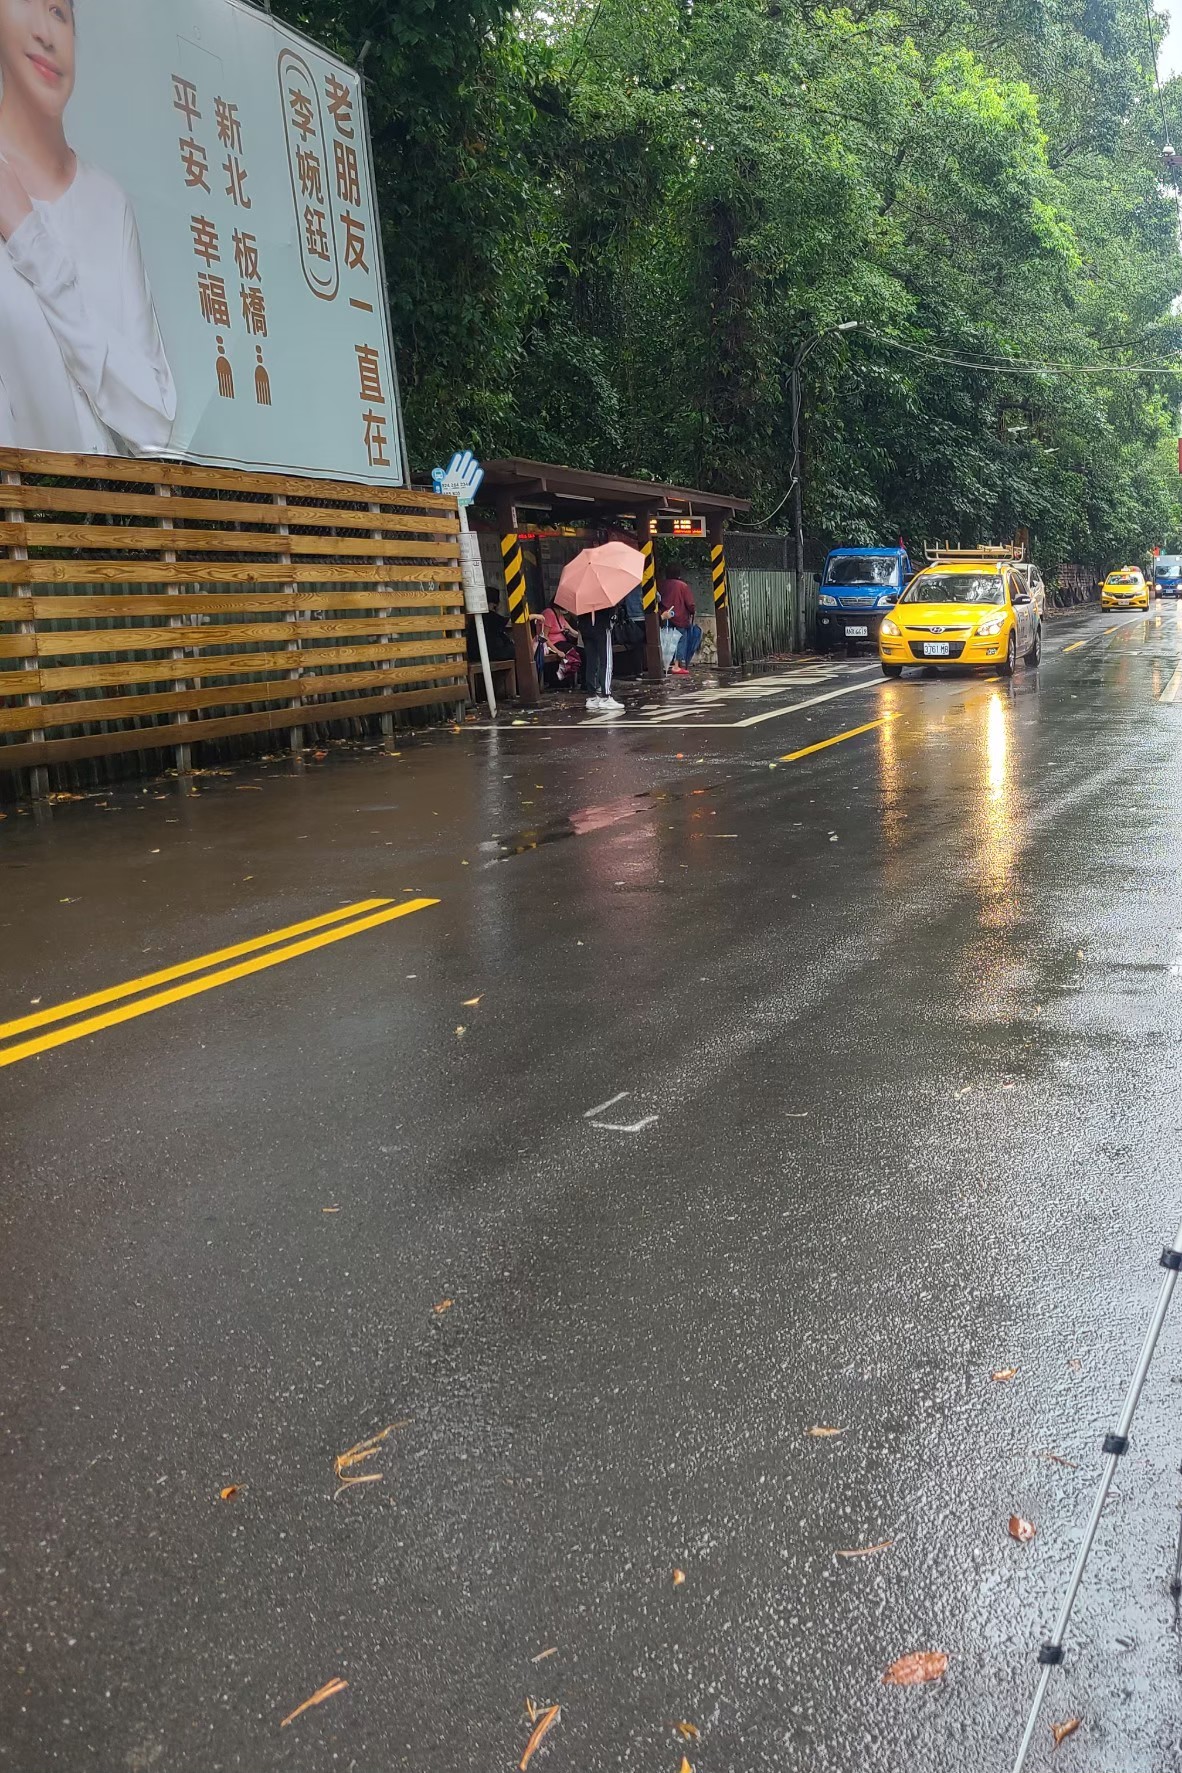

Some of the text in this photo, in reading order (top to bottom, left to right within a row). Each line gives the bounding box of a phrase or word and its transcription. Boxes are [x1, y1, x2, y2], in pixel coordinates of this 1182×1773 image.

[171, 74, 231, 330] 平安 幸福
[214, 95, 268, 338] 新北 板橋
[288, 88, 331, 264] 李婉鈺
[323, 73, 391, 468] 老朋友一直在
